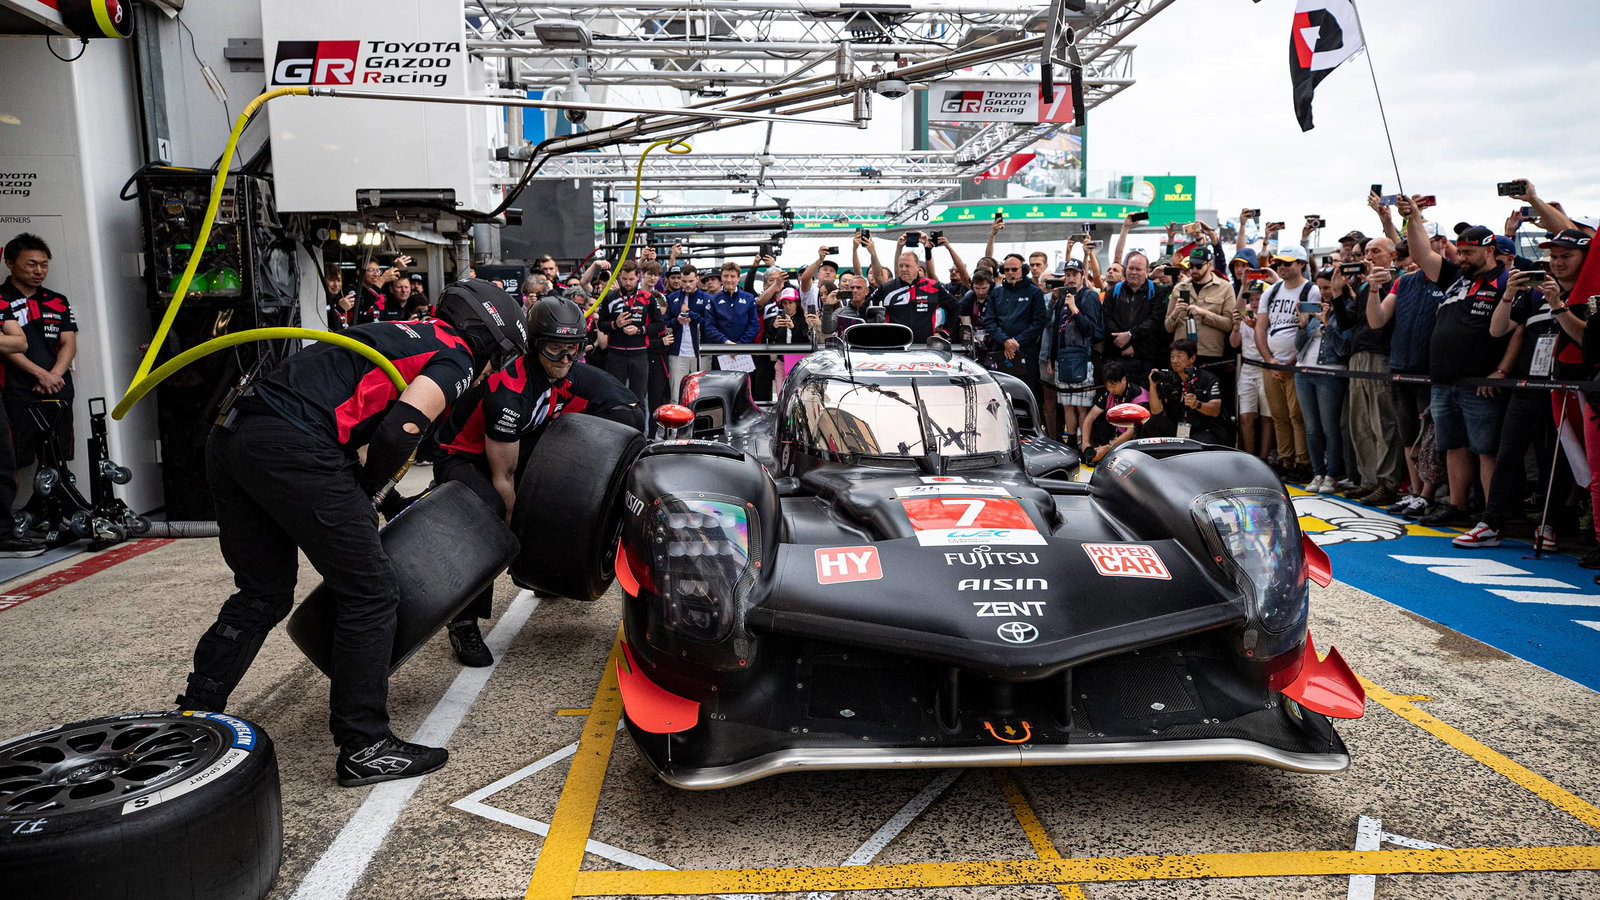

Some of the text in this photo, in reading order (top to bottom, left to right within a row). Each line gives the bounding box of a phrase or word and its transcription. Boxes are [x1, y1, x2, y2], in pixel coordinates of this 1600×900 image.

[115, 4, 123, 24] 8
[368, 41, 461, 53] TOYOTA
[365, 56, 451, 68] GAZOO
[274, 58, 354, 84] GR
[362, 71, 447, 87] Racing
[941, 99, 981, 113] GR
[983, 106, 1025, 115] Racing
[1045, 86, 1067, 120] 7
[161, 142, 168, 160] 1
[0, 188, 30, 197] cing
[1164, 193, 1192, 201] ROLEX
[854, 362, 952, 371] DENSO
[502, 407, 521, 419] AISIN
[941, 499, 986, 527] 7
[947, 530, 1011, 538] WEC
[943, 545, 1040, 569] FUJITSU
[1089, 546, 1153, 557] HYPER
[820, 551, 873, 577] HY
[1097, 555, 1164, 575] CAR
[957, 578, 1048, 591] AISIN
[973, 601, 1047, 617] ZENT
[211, 713, 253, 746] MICHELIN
[222, 752, 240, 768] PILOT
[190, 766, 221, 786] SPORT
[134, 796, 150, 809] S
